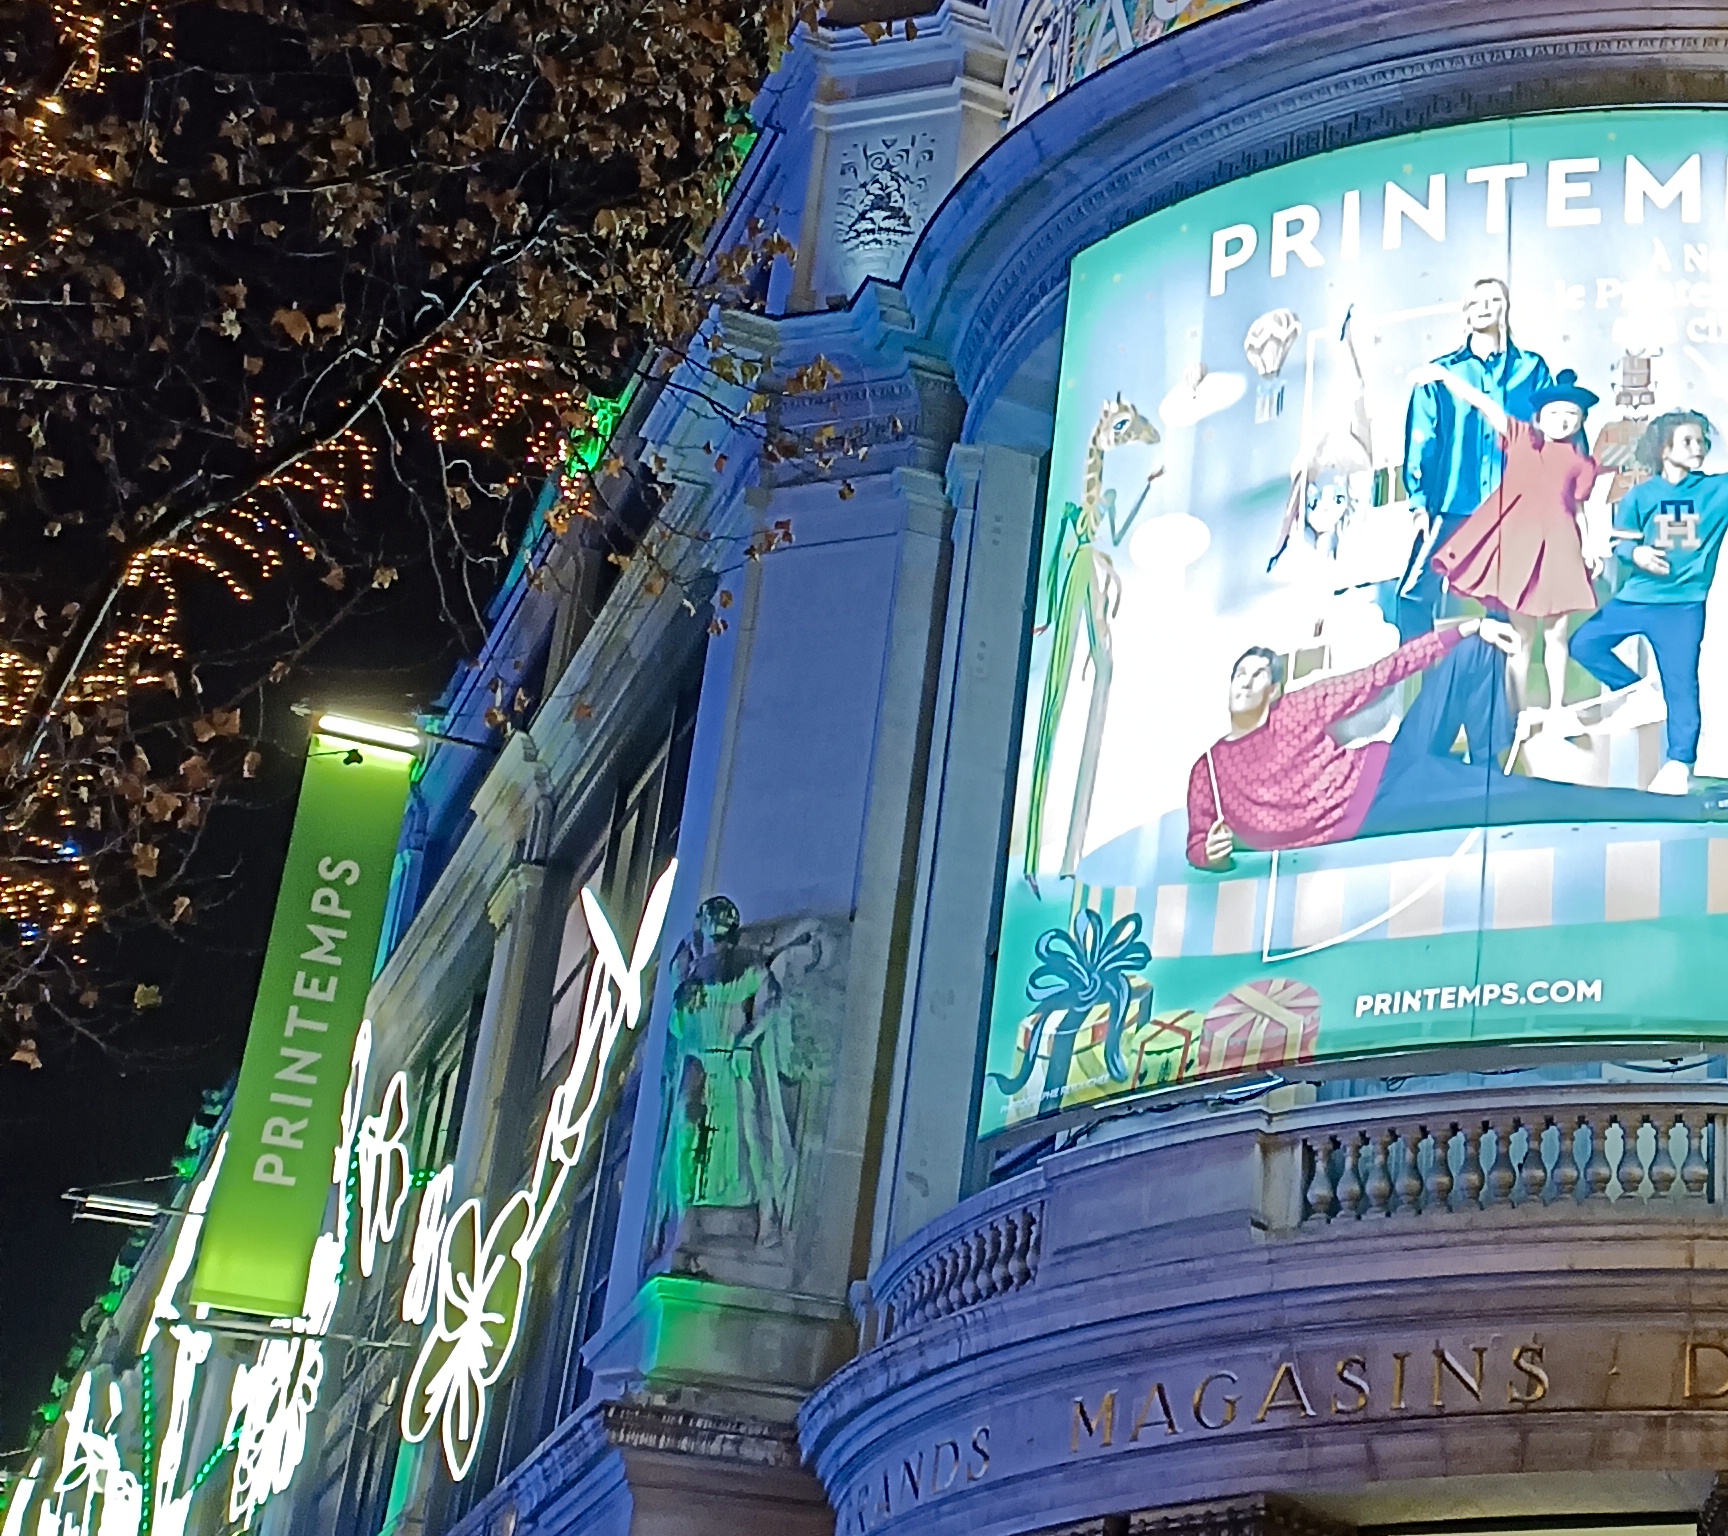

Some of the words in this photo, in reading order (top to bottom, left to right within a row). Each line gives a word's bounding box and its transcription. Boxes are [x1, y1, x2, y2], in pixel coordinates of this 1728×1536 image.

[252, 854, 360, 1187] PRINTEMPS
[1355, 978, 1603, 1018] PRINTEMPS.COM
[1070, 1333, 1552, 1452] MAGASINS
